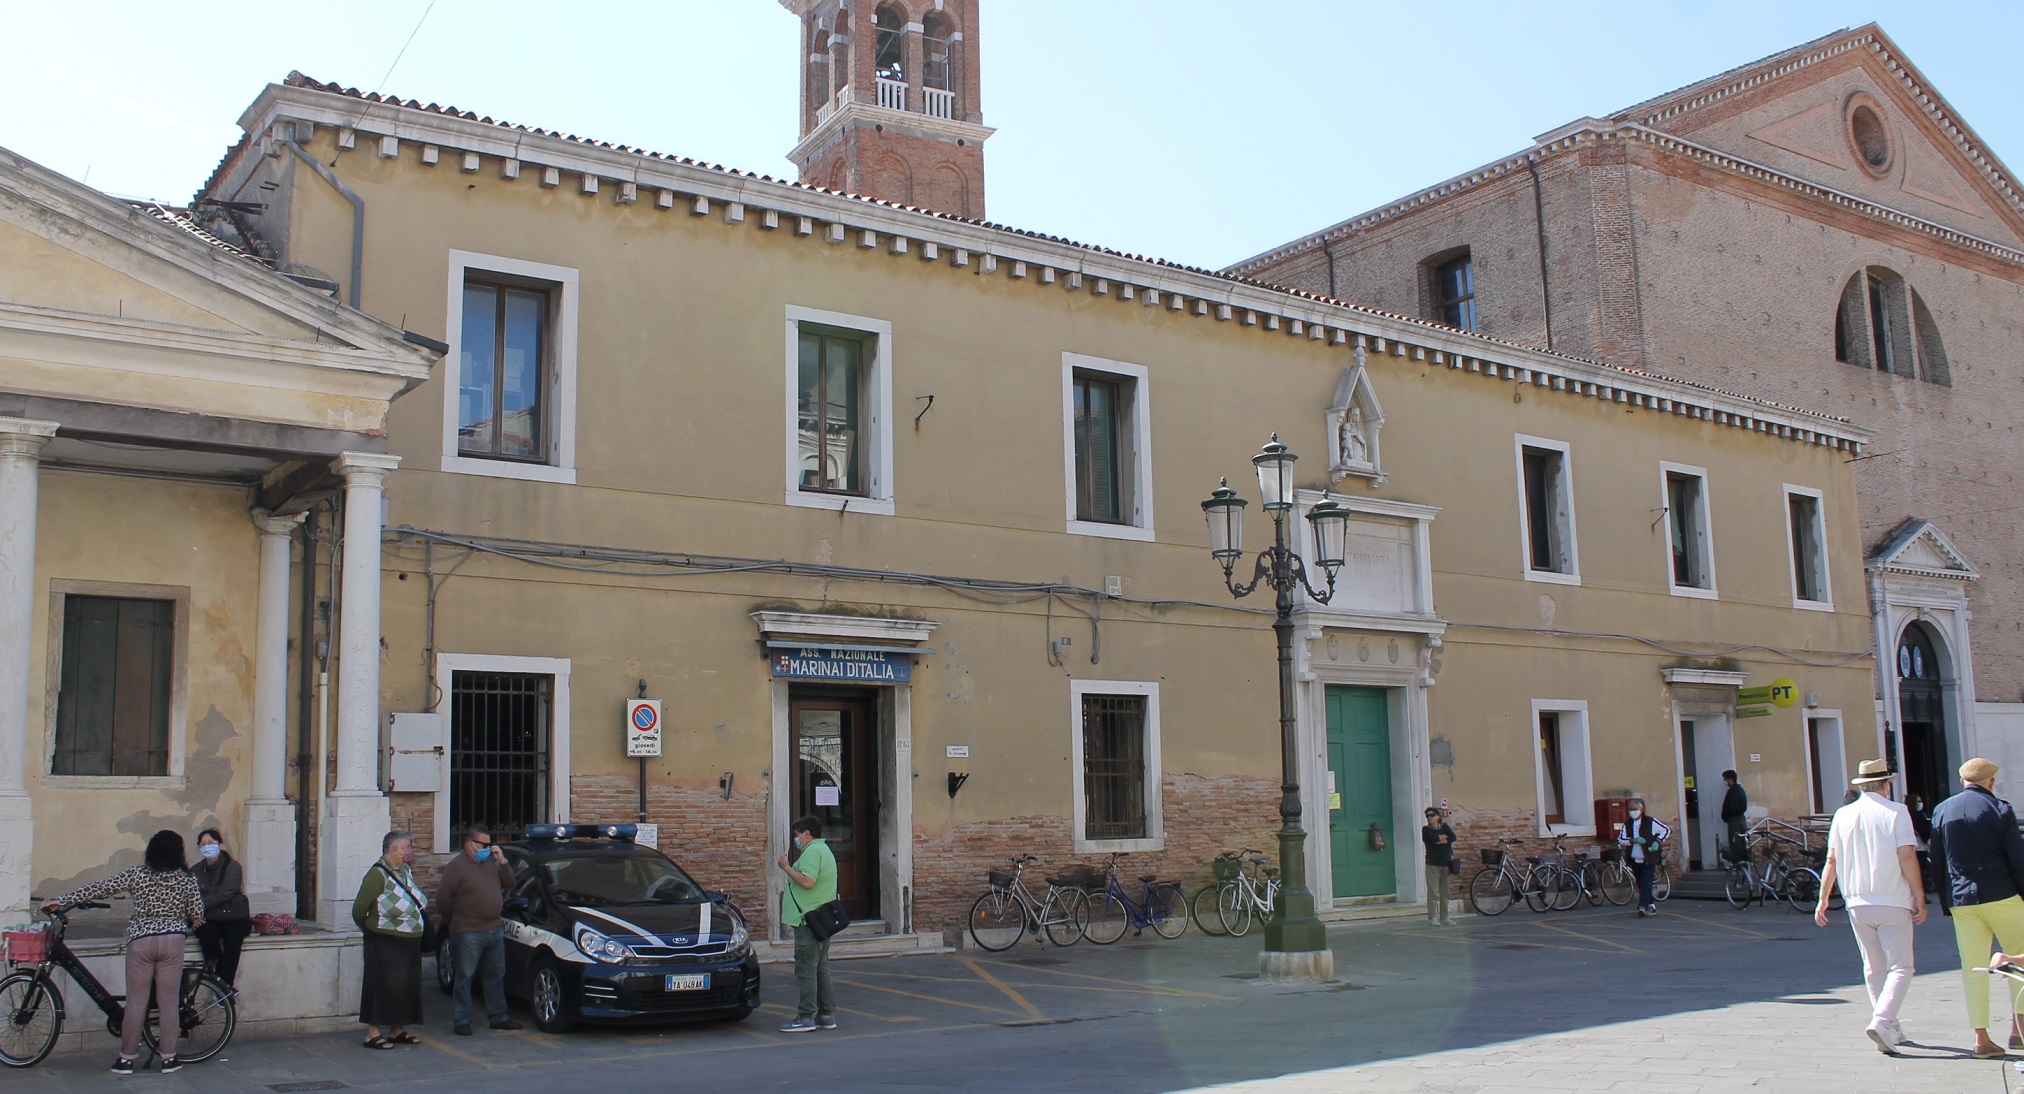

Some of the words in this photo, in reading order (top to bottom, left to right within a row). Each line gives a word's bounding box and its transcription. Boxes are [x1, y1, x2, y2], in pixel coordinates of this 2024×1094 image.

[800, 648, 821, 658] ASS.
[830, 649, 886, 661] NAZIONALE
[790, 659, 844, 677] MARINAI
[1772, 685, 1792, 700] PT
[503, 921, 521, 939] CALE
